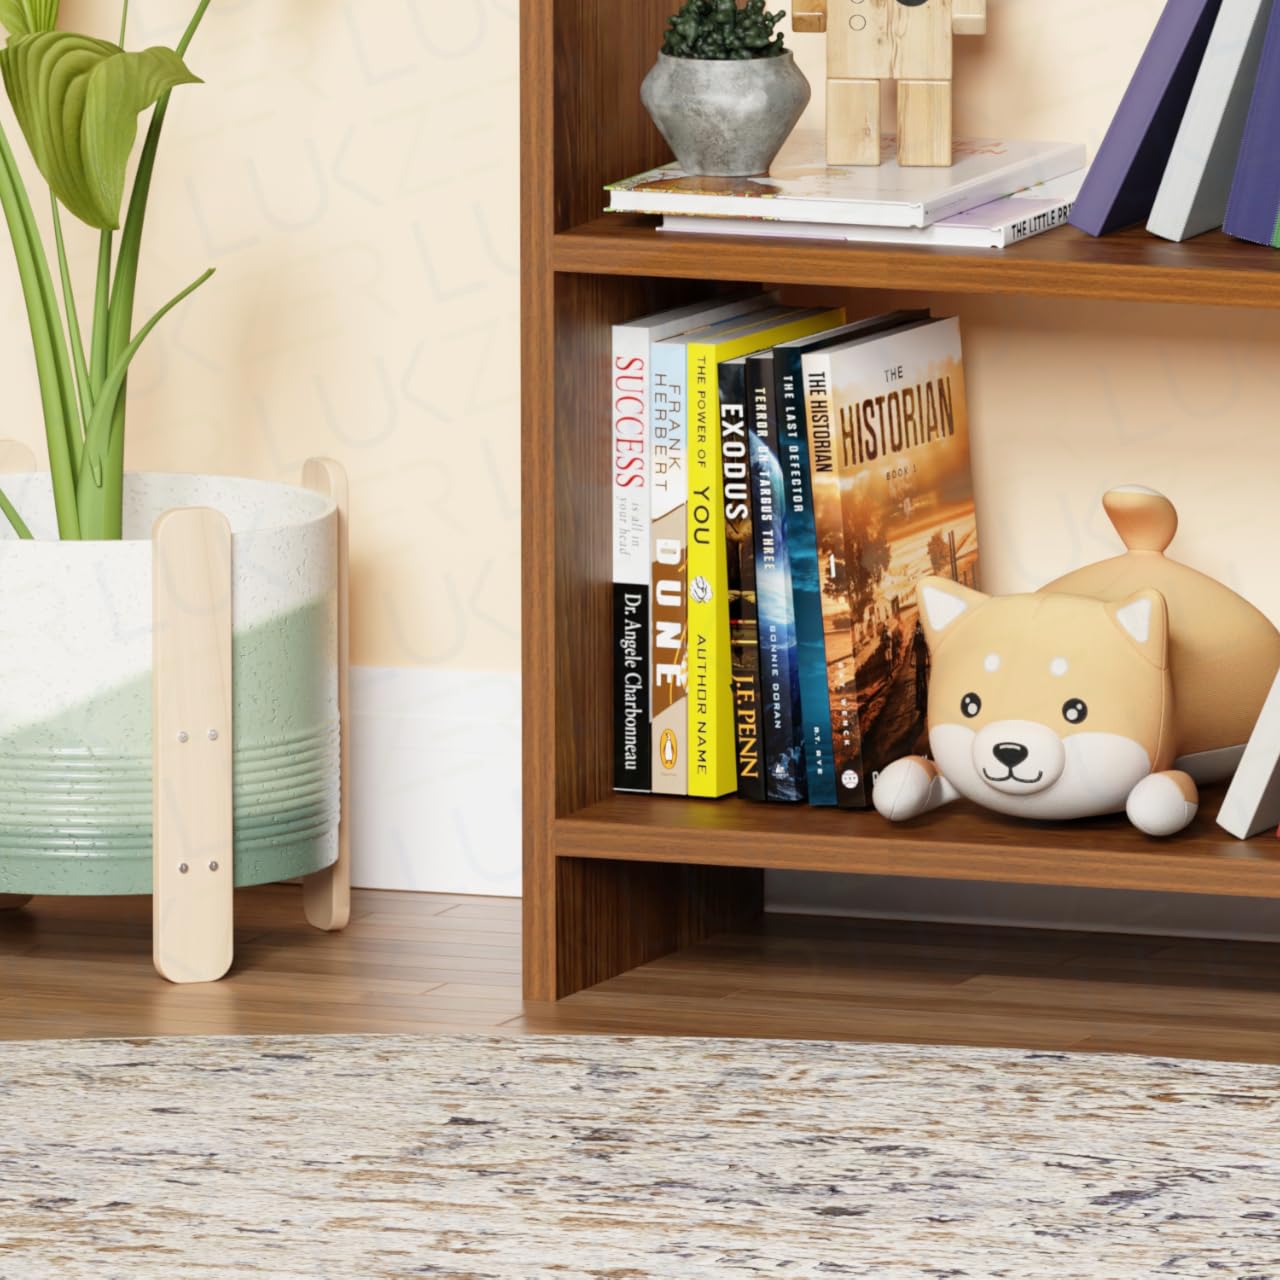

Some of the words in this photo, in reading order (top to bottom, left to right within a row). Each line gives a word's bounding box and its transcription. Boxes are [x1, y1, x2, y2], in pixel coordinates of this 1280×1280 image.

[1012, 220, 1027, 240] THE
[1029, 209, 1056, 233] LITTLE
[697, 356, 707, 384] THE
[783, 375, 795, 399] THE
[808, 371, 827, 396] THE
[884, 365, 904, 383] THE
[615, 355, 645, 489] SUCCESS
[654, 372, 668, 493] HERBERT
[668, 383, 681, 471] FRANK
[697, 390, 707, 443] POWER
[754, 387, 768, 437] TERROR
[785, 407, 798, 438] LAST
[810, 400, 833, 473] HISTORIAN
[840, 375, 955, 467] HISTORIAN
[697, 449, 708, 469] OF
[720, 403, 749, 521] EXODUS
[788, 445, 803, 513] DEFECTOR
[885, 469, 909, 481] BOOK
[693, 486, 711, 545] YOU
[759, 472, 772, 522] TARGUS
[762, 530, 775, 570] THREE
[624, 592, 642, 615] Dr.
[655, 538, 682, 688] DUNE
[619, 618, 643, 669] Angele
[769, 625, 780, 677] BONNIE
[697, 634, 707, 714] AUTHOR
[731, 674, 755, 705] J.F.
[624, 672, 643, 771] Charbonneau
[772, 682, 782, 729] DORAN
[697, 721, 708, 775] NAME
[738, 708, 758, 779] PENN
